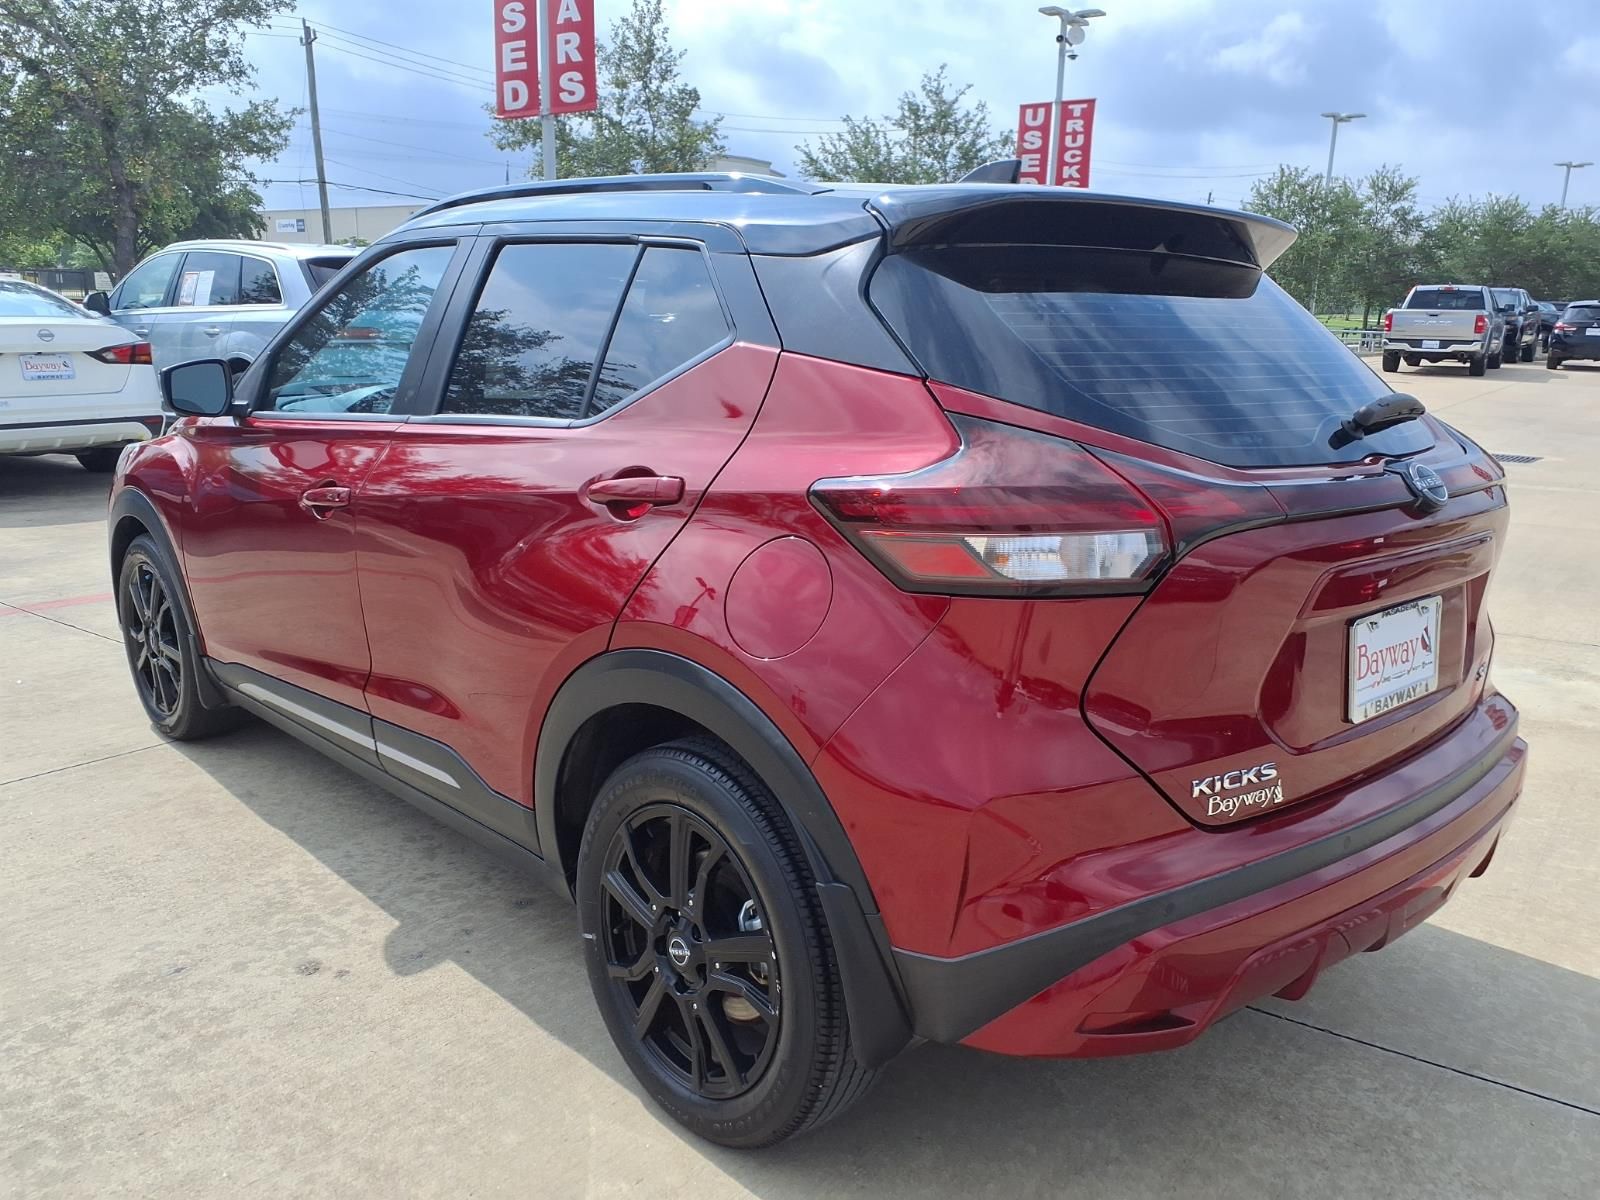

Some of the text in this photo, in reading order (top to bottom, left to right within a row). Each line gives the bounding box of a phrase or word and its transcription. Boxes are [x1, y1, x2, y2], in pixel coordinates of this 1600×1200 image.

[25, 360, 61, 372] Bayway
[1356, 637, 1419, 686] Bayway
[1375, 684, 1419, 714] BAYWAY
[1191, 762, 1278, 798] KICKS
[1207, 785, 1274, 817] Bayway
